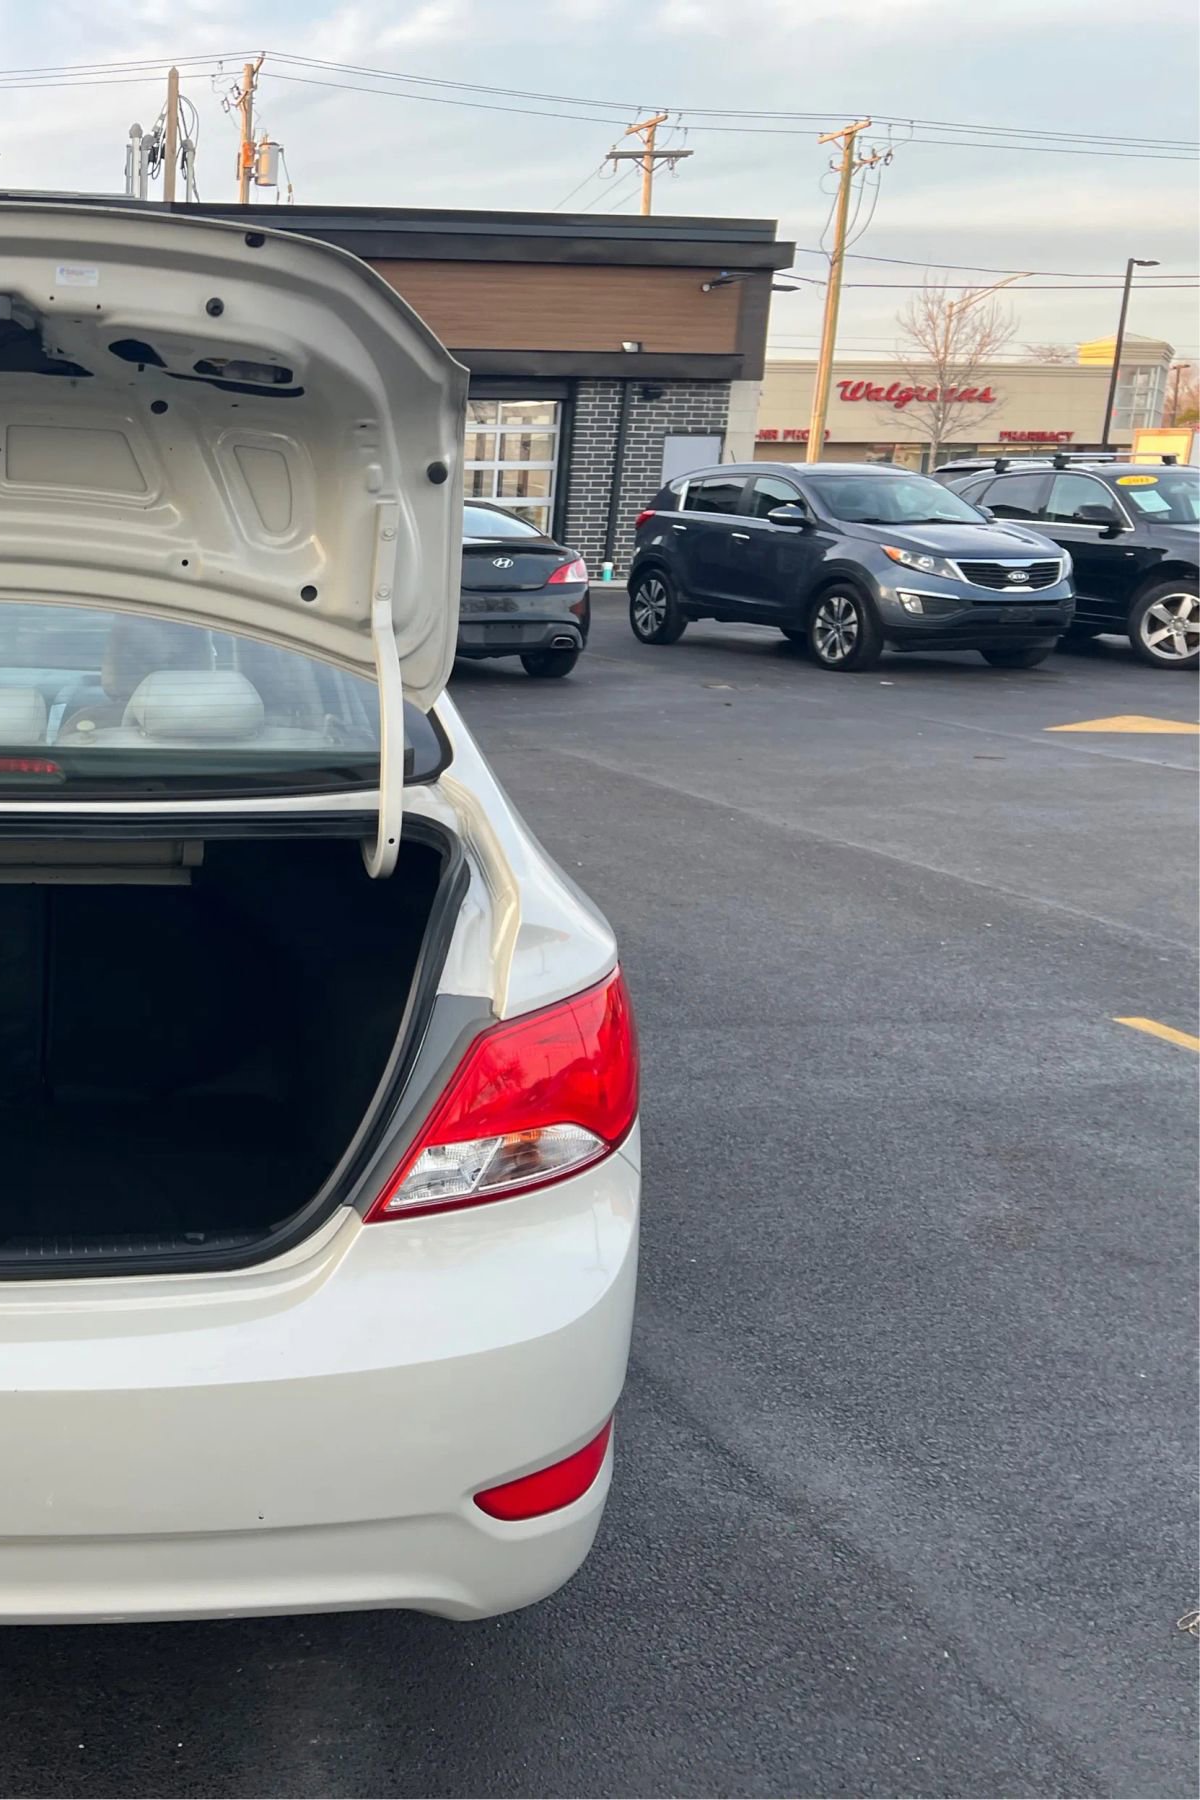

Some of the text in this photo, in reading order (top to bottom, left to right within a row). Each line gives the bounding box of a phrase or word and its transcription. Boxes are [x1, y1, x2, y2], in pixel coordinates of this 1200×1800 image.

[837, 380, 997, 409] Walgreens
[782, 429, 831, 441] PHOO
[999, 431, 1075, 442] PHARMACY
